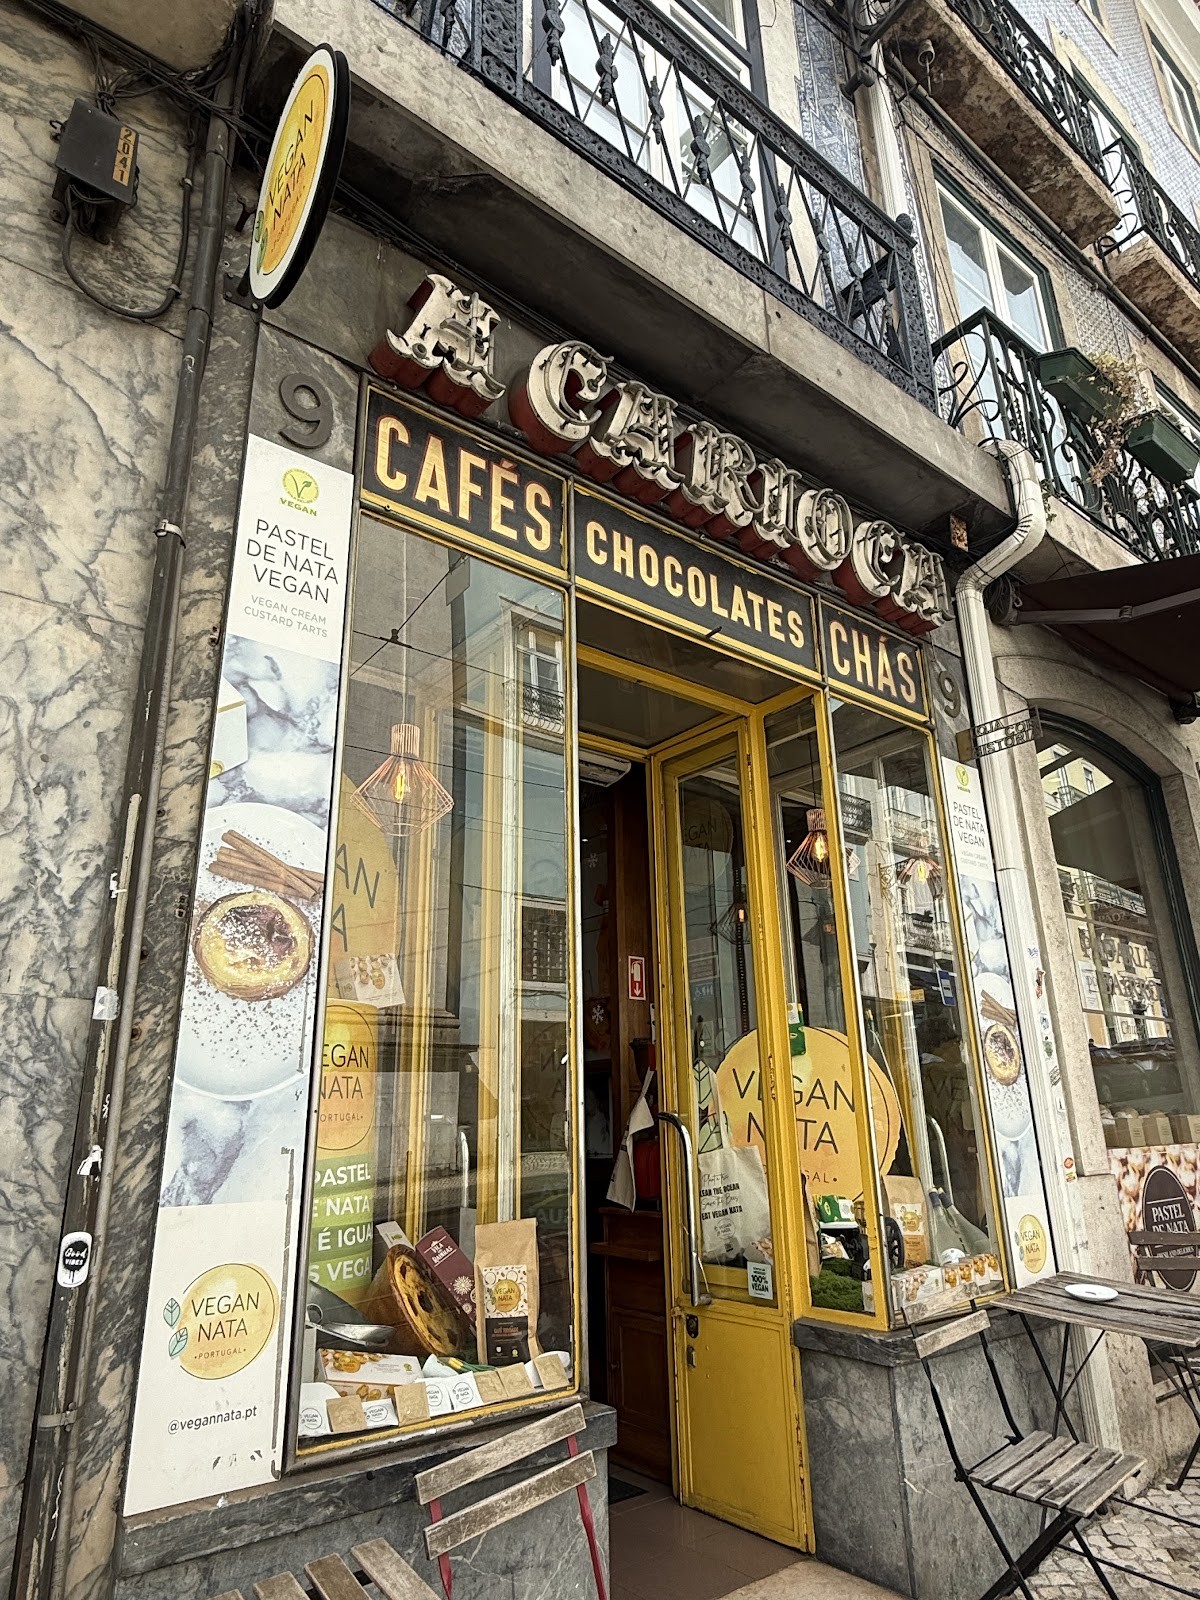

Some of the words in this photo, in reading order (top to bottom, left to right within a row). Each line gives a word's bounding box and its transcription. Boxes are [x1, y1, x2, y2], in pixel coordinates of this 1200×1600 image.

[118, 128, 132, 182] 2041
[269, 100, 313, 206] VEGAN
[272, 152, 307, 230] NATA
[279, 372, 334, 449] 9
[375, 414, 553, 552] CAFÉS
[279, 497, 318, 517] VEGAN
[256, 518, 334, 561] PASTEL
[246, 538, 277, 564] DE
[283, 551, 339, 585] NATA
[253, 563, 329, 604] VEGAN
[585, 521, 806, 649] CHOCOLATES
[244, 606, 293, 627] CUSTARD
[296, 621, 328, 638] TARTS
[251, 595, 289, 614] VEGAN
[291, 607, 327, 625] CREAM
[828, 620, 917, 704] CHÁS
[938, 670, 962, 719] 9
[976, 719, 1005, 738] OJA
[953, 801, 982, 820] PASTEL
[953, 815, 964, 828] DE
[965, 819, 985, 835] NATA
[957, 831, 985, 848] VEGAN
[319, 1112, 361, 1122] ORTUGAL
[746, 1111, 839, 1154] NTA
[713, 1186, 723, 1195] THE
[723, 1182, 740, 1193] OCEAN
[325, 1195, 371, 1217] NATA
[701, 1211, 711, 1221] EAT
[712, 1208, 728, 1219] VEGAN
[729, 1205, 743, 1215] NATA
[1151, 1203, 1185, 1223] PASTEL
[317, 1226, 332, 1251] É
[1020, 1229, 1041, 1241] VEGAN
[1025, 1243, 1040, 1254] NATA
[495, 1287, 515, 1295] VEGAN
[751, 1274, 769, 1285] 100%
[751, 1283, 769, 1293] VEGAN
[192, 1291, 260, 1317] VEGAN
[198, 1318, 248, 1342] NATA
[196, 1347, 244, 1359] PORTUGAL
[168, 1405, 258, 1435] @vegannata.pt
